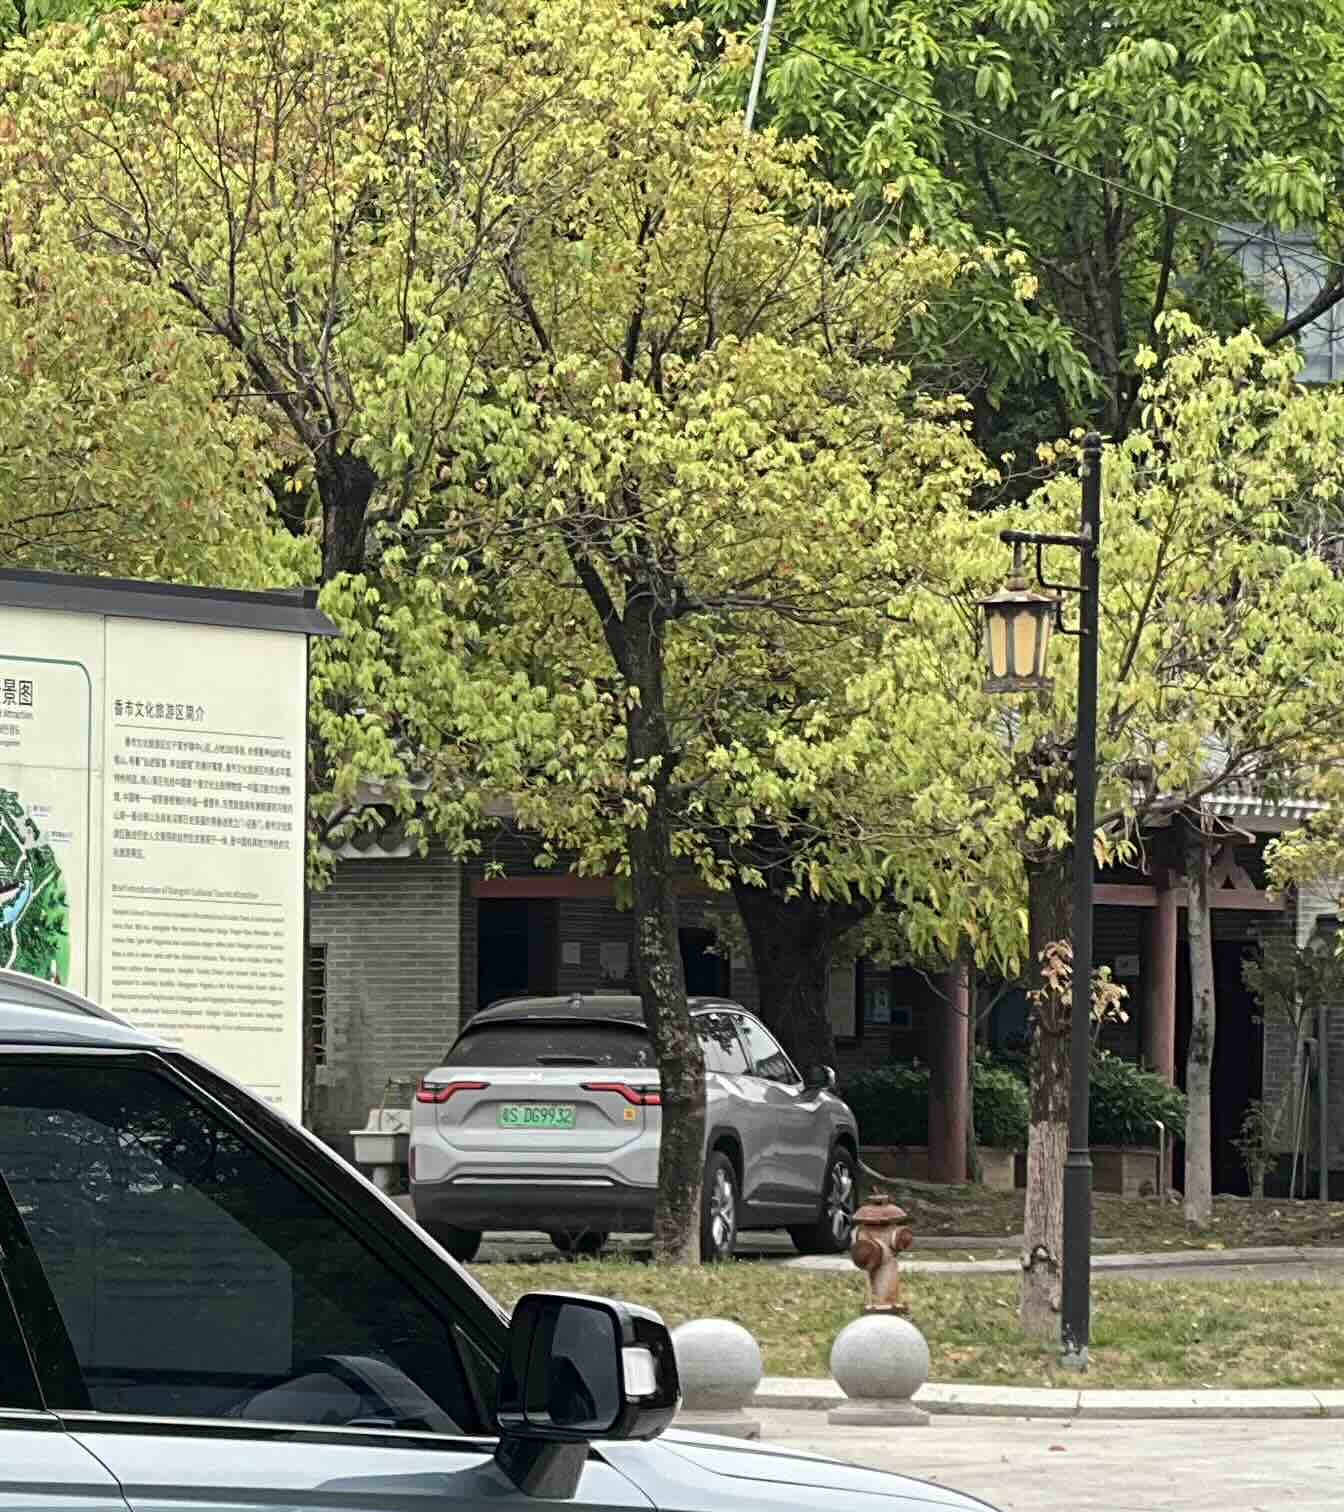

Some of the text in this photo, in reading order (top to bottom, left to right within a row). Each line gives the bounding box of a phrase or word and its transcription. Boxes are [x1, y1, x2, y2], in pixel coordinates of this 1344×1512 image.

[113, 698, 206, 722] 香市文化旅游区简介
